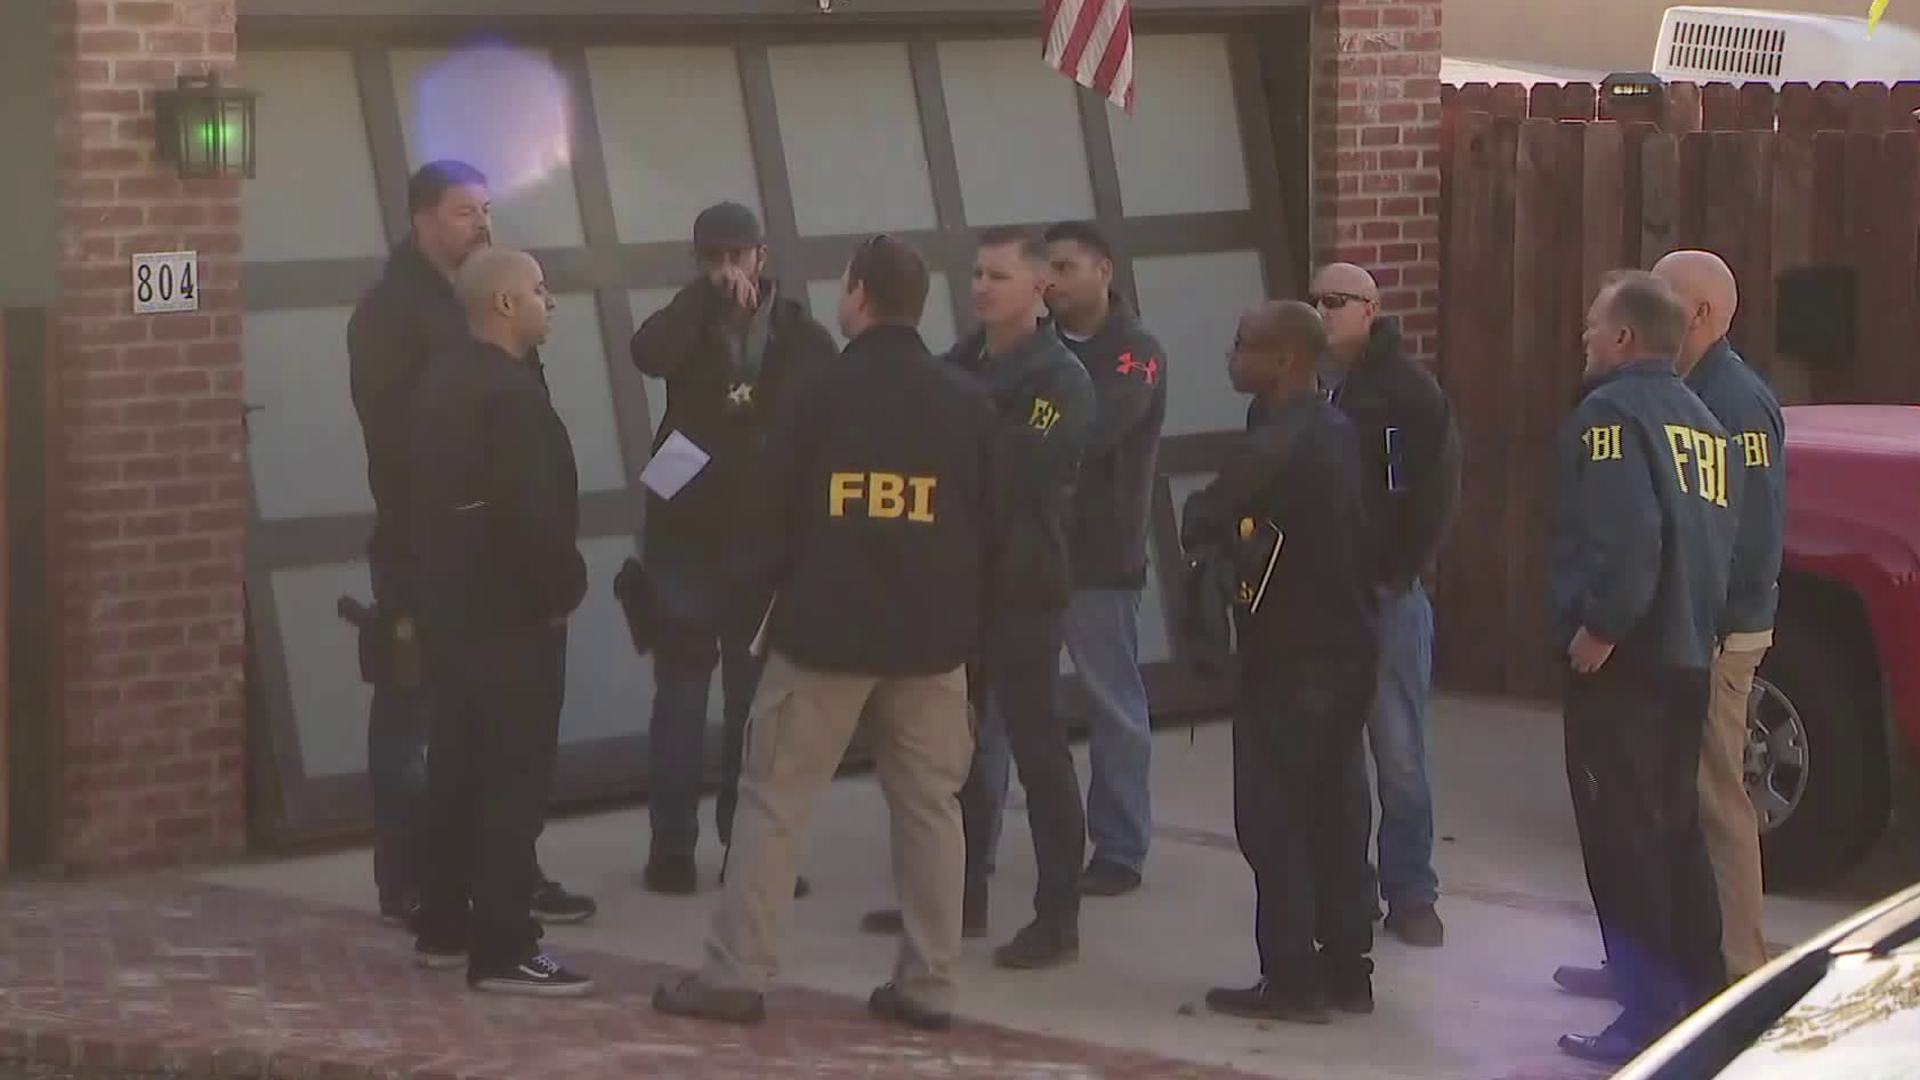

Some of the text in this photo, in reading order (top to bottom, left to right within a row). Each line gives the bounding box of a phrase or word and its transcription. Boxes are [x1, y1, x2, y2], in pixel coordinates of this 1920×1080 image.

[138, 262, 193, 302] 804
[1663, 424, 1728, 508] FBI
[1732, 430, 1770, 467] BI
[829, 472, 937, 523] FBI
